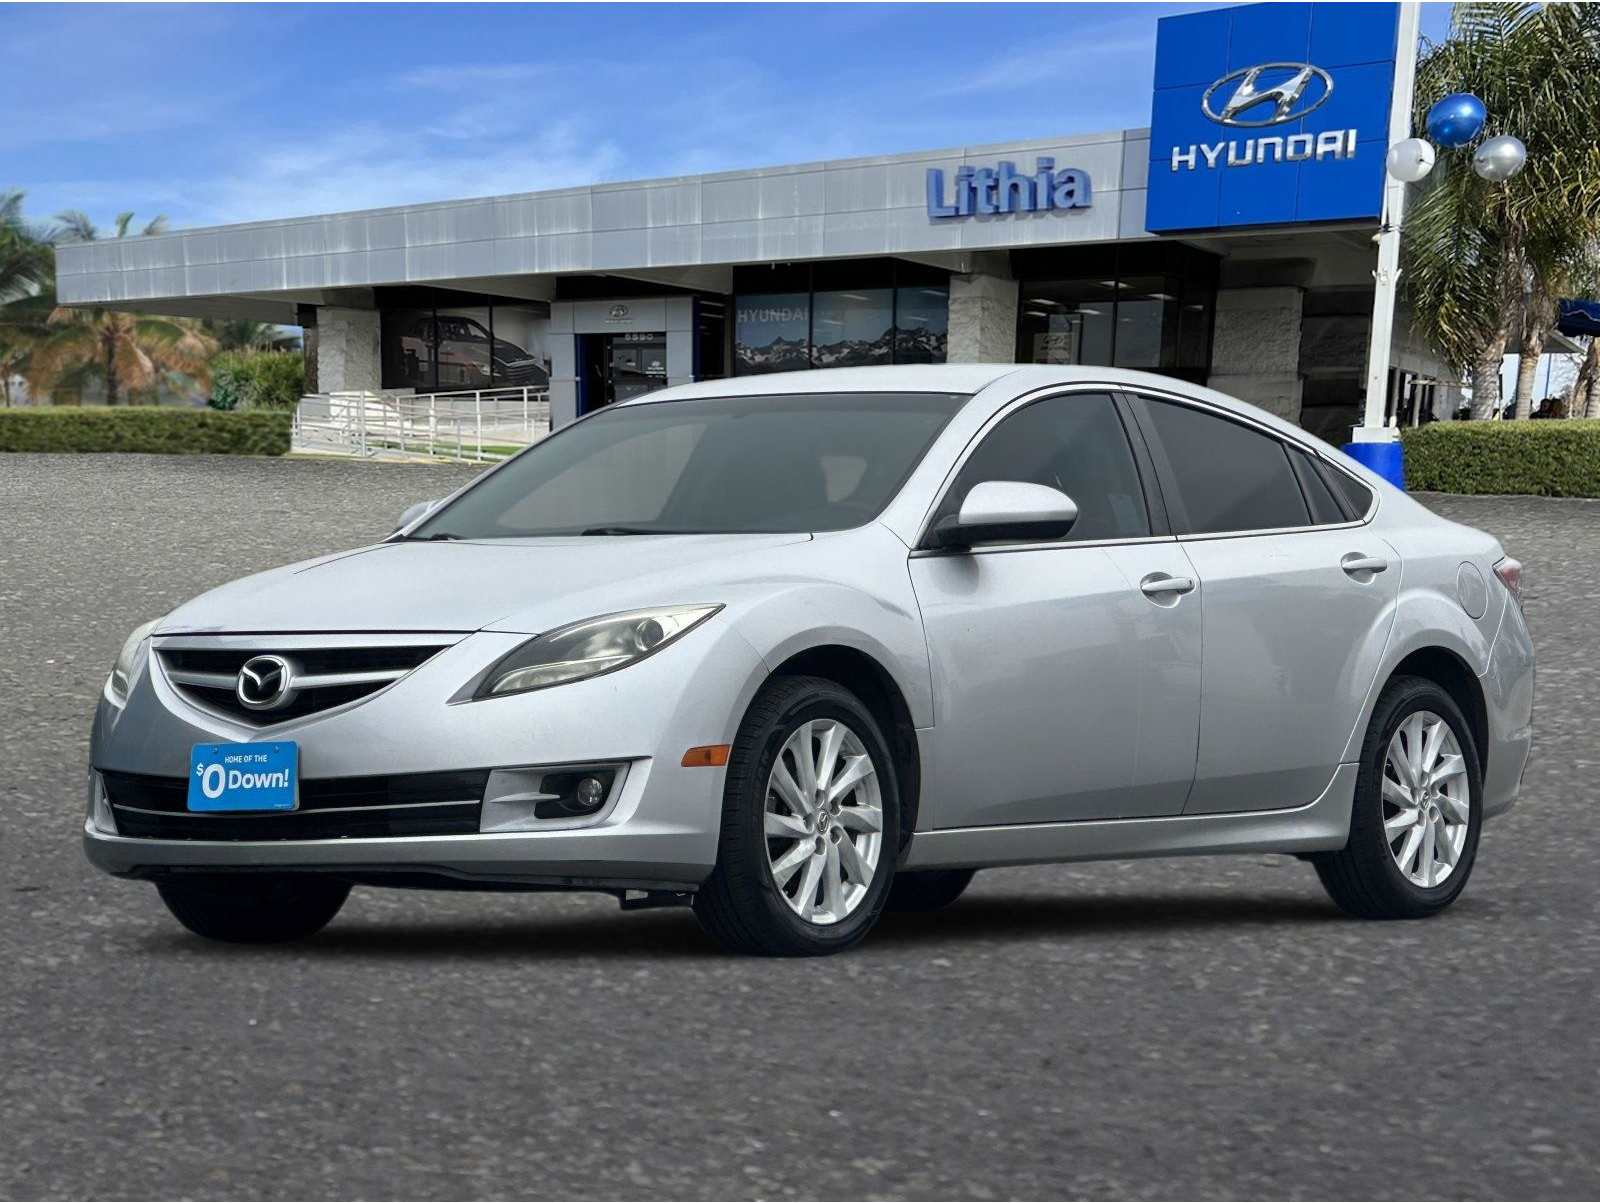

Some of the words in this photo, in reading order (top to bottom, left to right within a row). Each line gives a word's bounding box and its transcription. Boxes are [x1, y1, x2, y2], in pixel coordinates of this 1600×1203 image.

[1171, 128, 1357, 172] HYUNDAI
[926, 156, 1092, 218] Lithia
[737, 306, 808, 323] HYUNDAI
[225, 755, 242, 763] HOME
[244, 755, 253, 763] OF
[254, 754, 268, 763] THE
[228, 768, 289, 789] Down!
